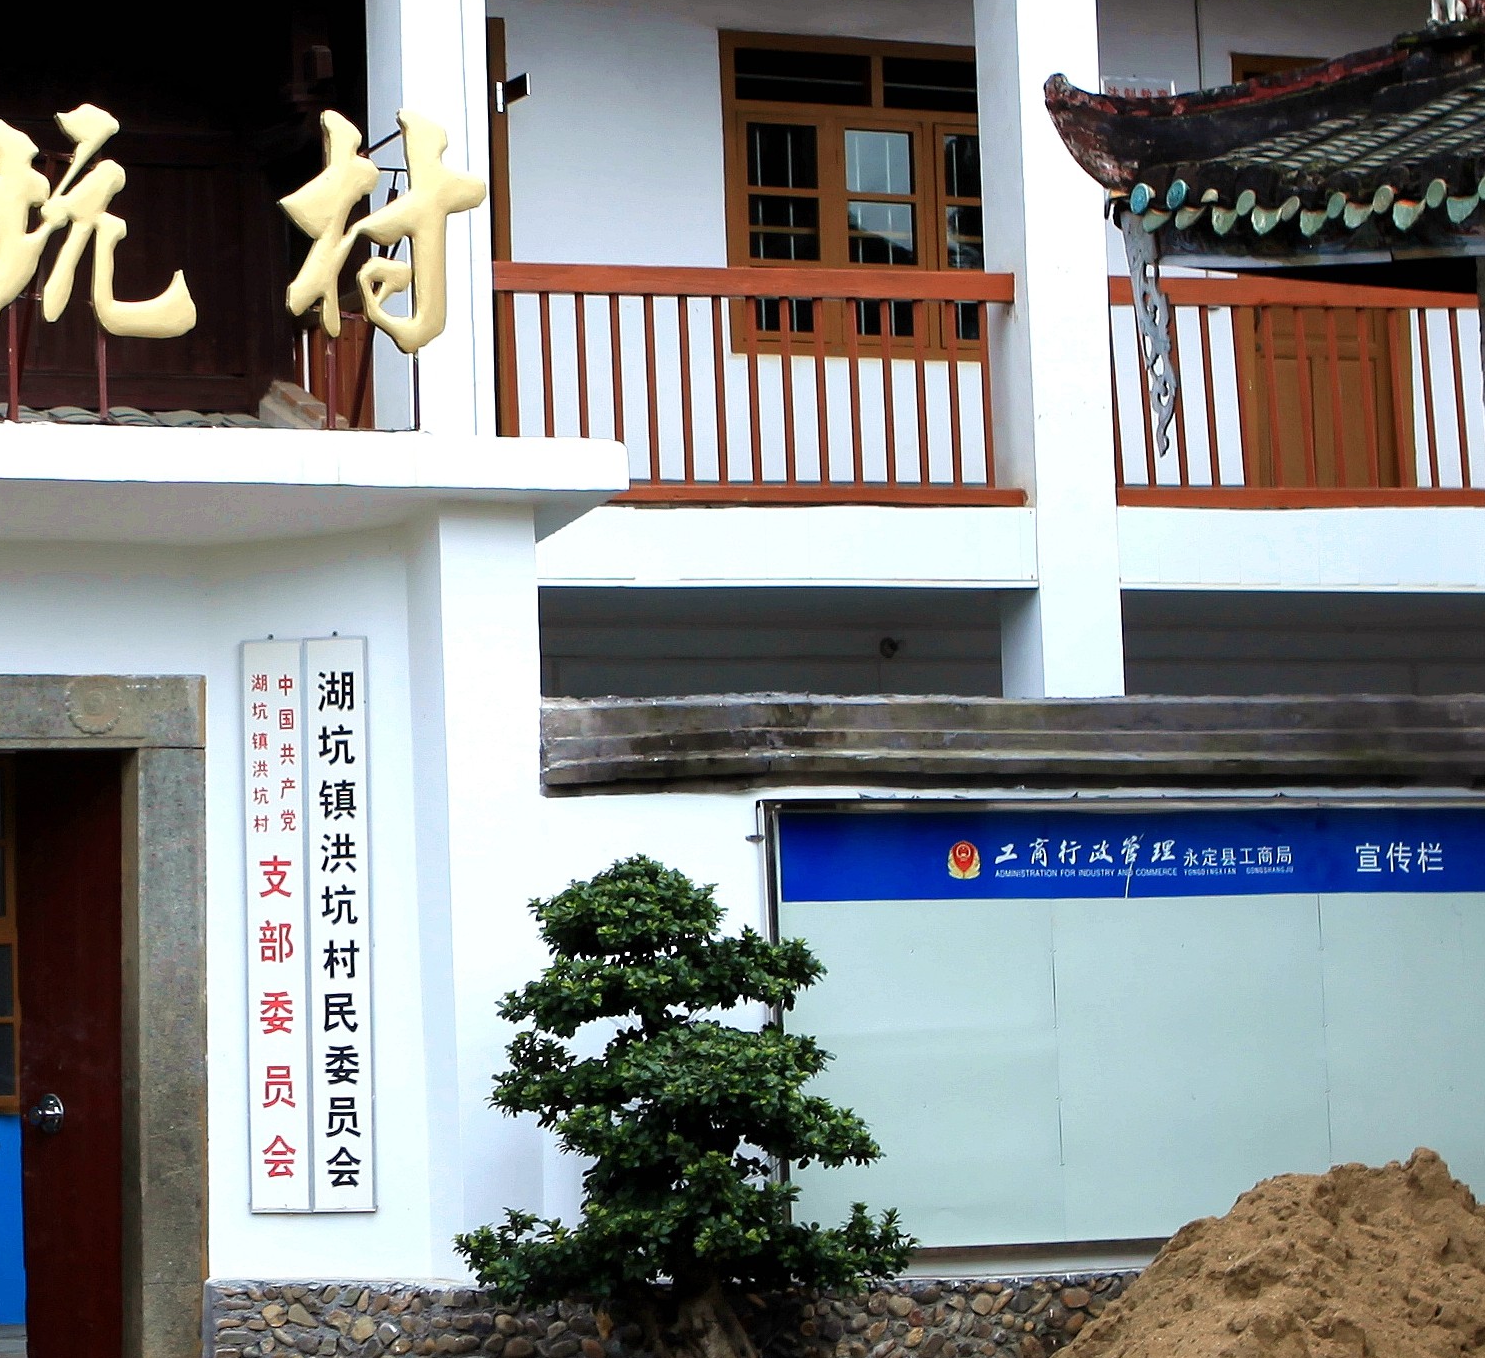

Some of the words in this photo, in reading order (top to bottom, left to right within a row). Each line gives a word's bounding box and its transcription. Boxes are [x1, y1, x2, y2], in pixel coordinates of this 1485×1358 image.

[251, 674, 269, 833] 湖坑镇洪坑村
[278, 674, 296, 832] 中国共产党
[317, 671, 362, 1188] 湖坑镇洪坑村民委员会
[995, 835, 1176, 865] 工商行政管理
[1183, 845, 1292, 867] 永定县工商局
[1355, 842, 1444, 873] 宣传栏
[995, 868, 1057, 878] ADMINISTRATION
[1060, 868, 1076, 877] FOR
[1078, 868, 1115, 877] INDUSTRY
[1135, 867, 1178, 876] COMMERCE
[258, 855, 297, 1178] 支部委员会
